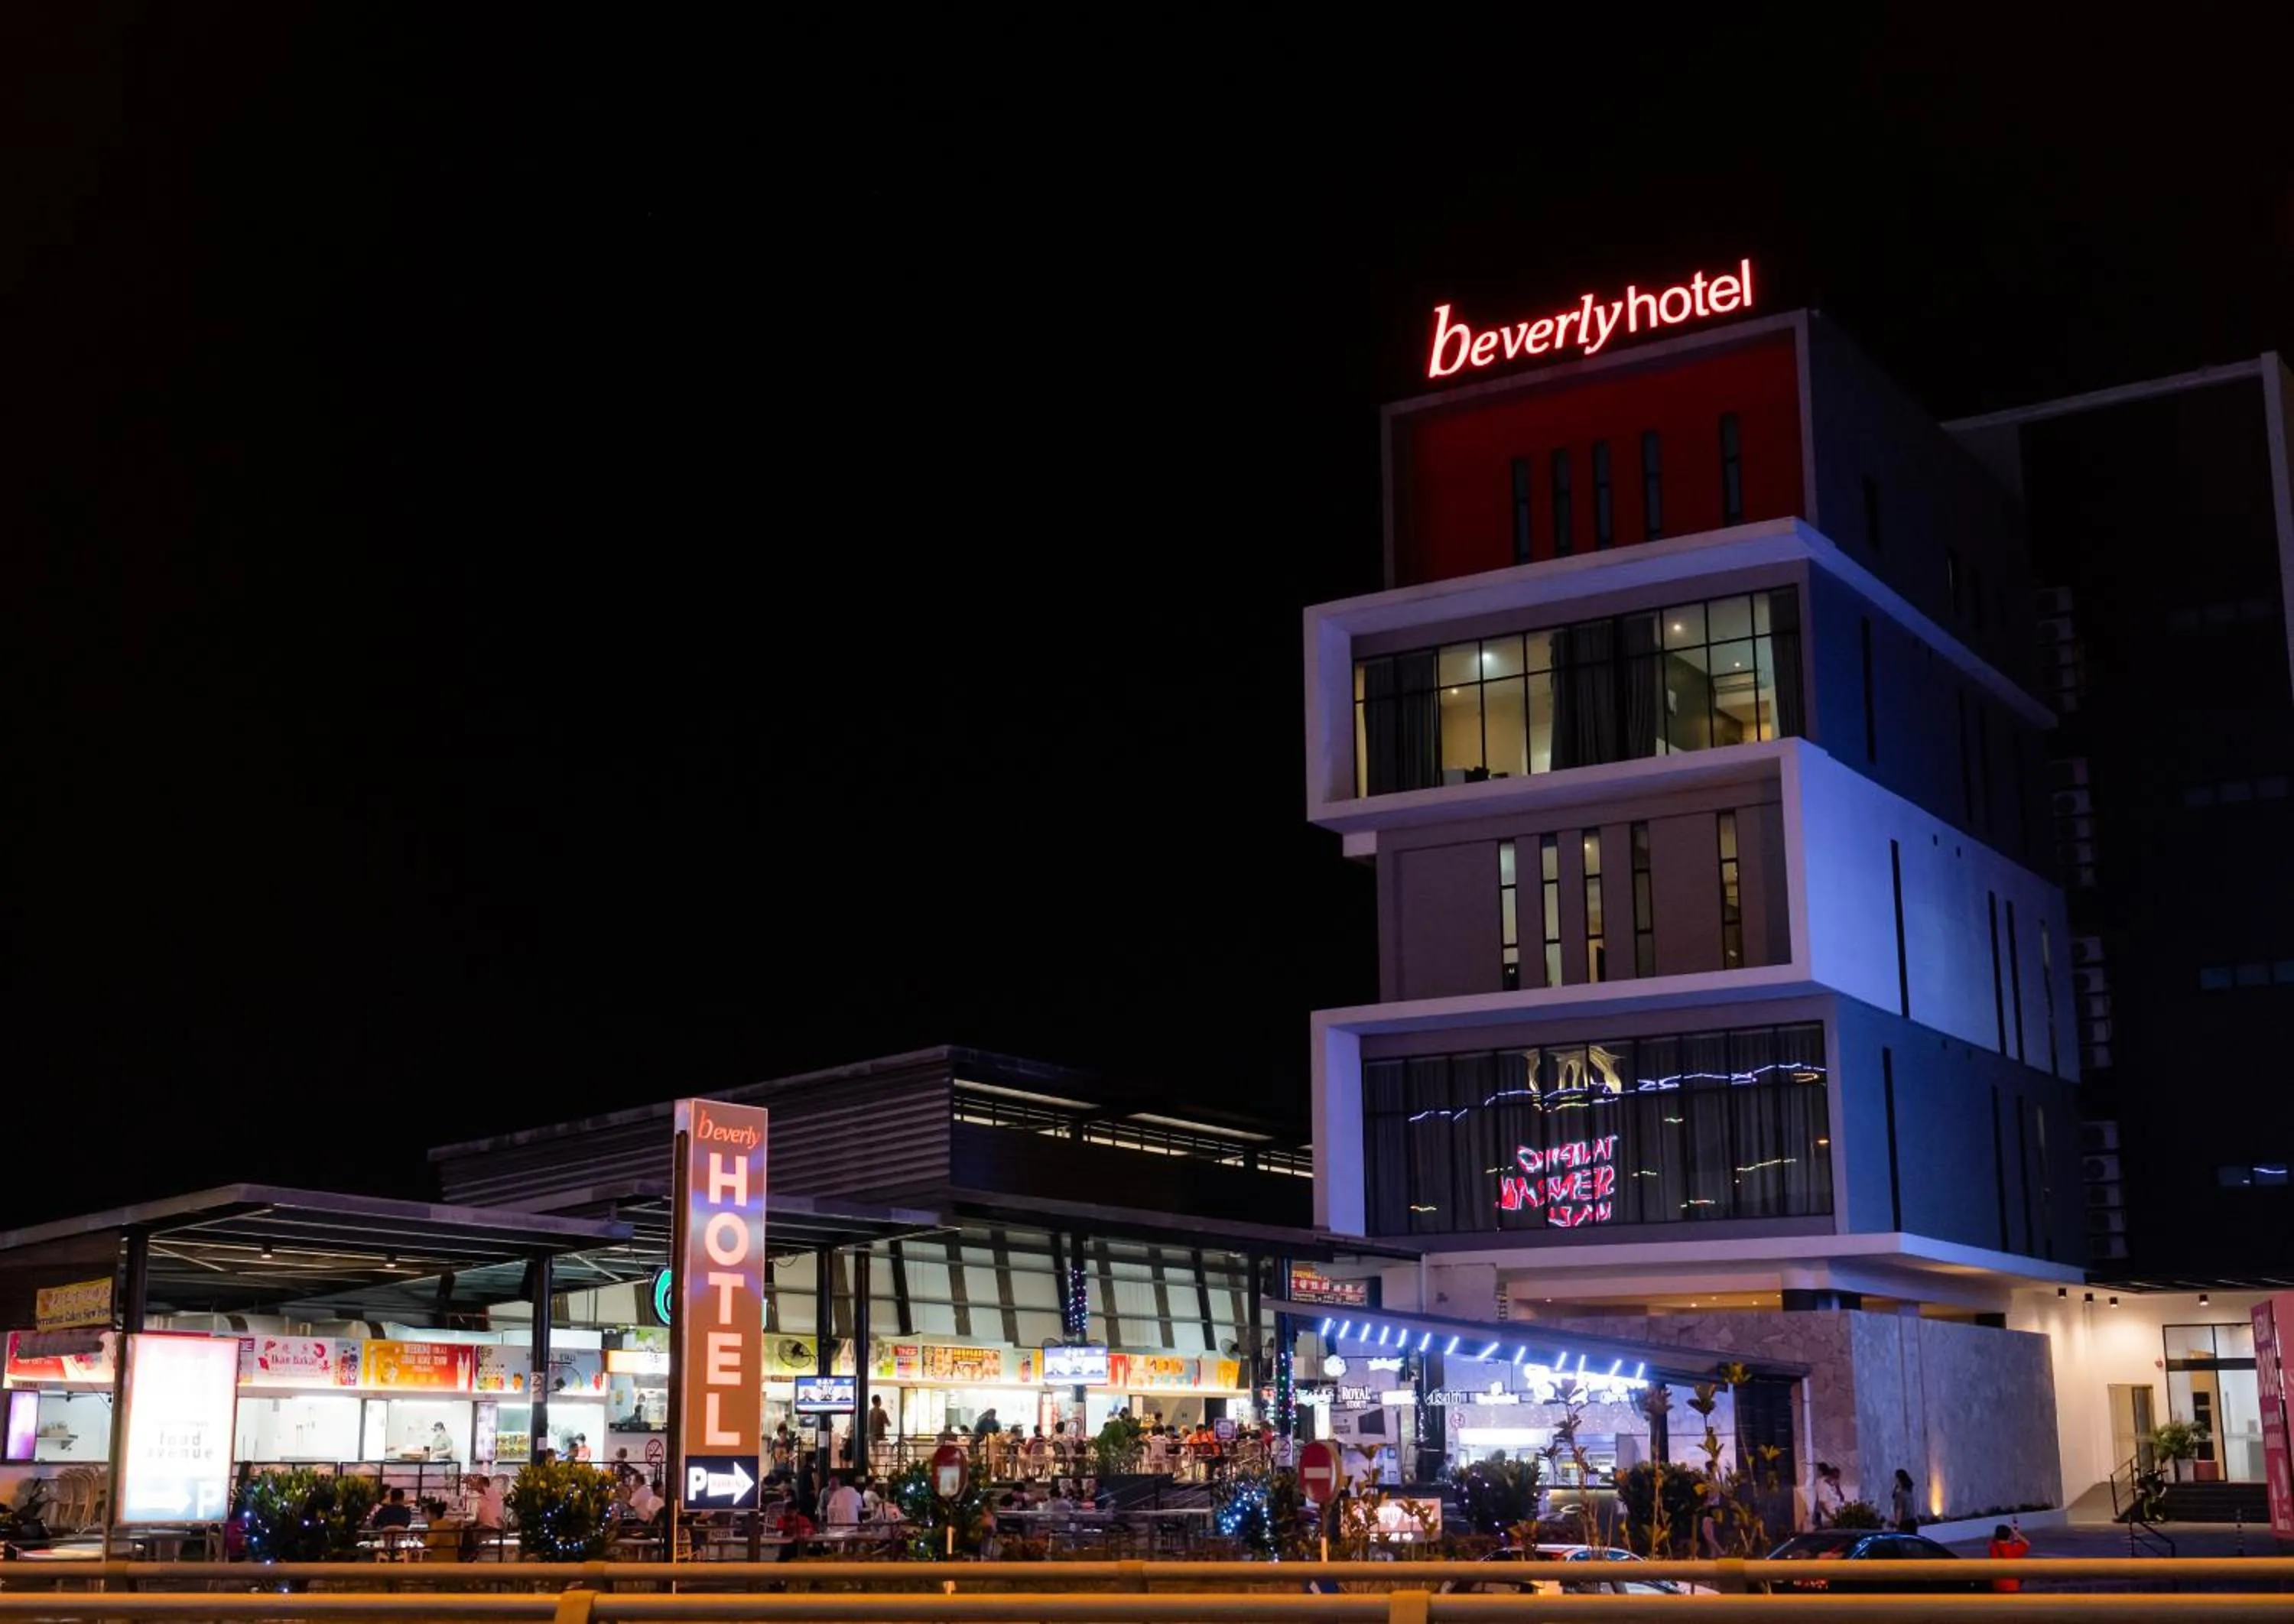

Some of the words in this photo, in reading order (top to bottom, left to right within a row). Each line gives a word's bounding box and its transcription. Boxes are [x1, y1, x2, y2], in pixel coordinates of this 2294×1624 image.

[697, 1108, 761, 1149] beverly
[704, 1151, 749, 1447] HOTEL
[1342, 1385, 1371, 1401] ROYAL
[688, 1466, 707, 1501] P
